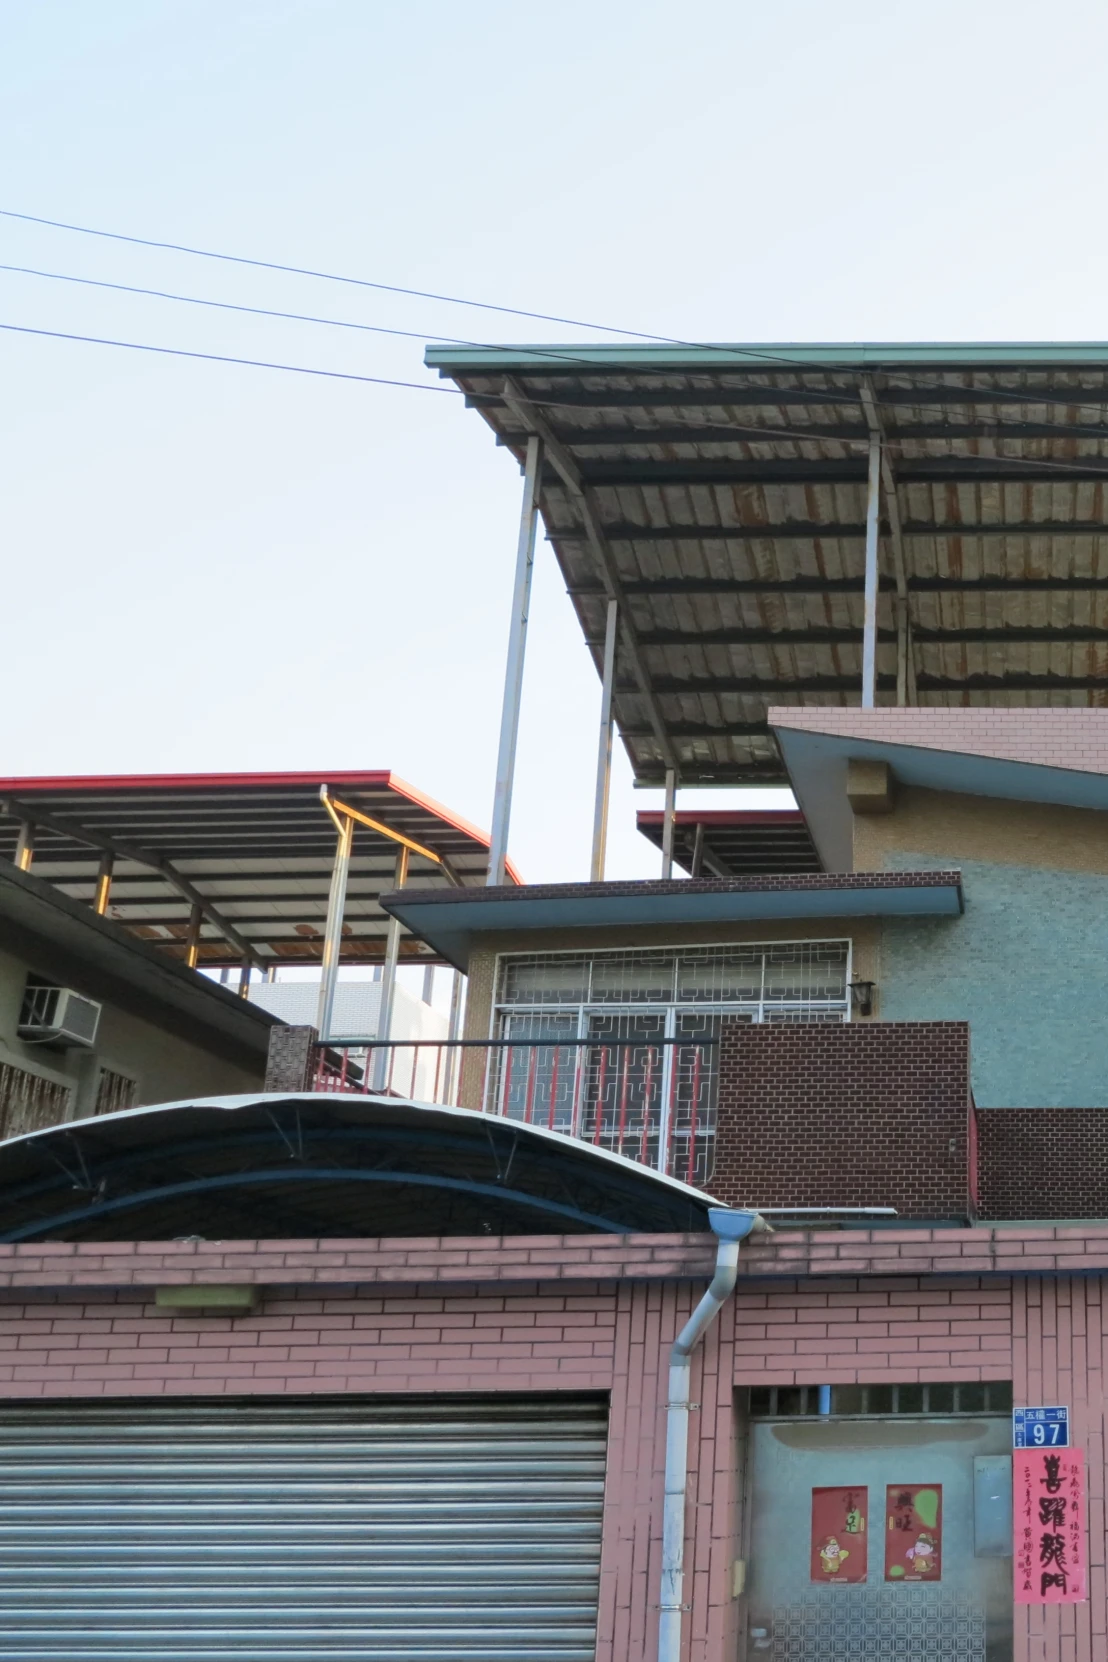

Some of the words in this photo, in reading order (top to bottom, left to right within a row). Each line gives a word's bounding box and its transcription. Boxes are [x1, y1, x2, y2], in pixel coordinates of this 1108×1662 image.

[1026, 1409, 1066, 1420] 五權一街
[1033, 1424, 1060, 1445] 97
[894, 1491, 914, 1532] 興旺
[1038, 1453, 1070, 1597] 喜躍龍門
